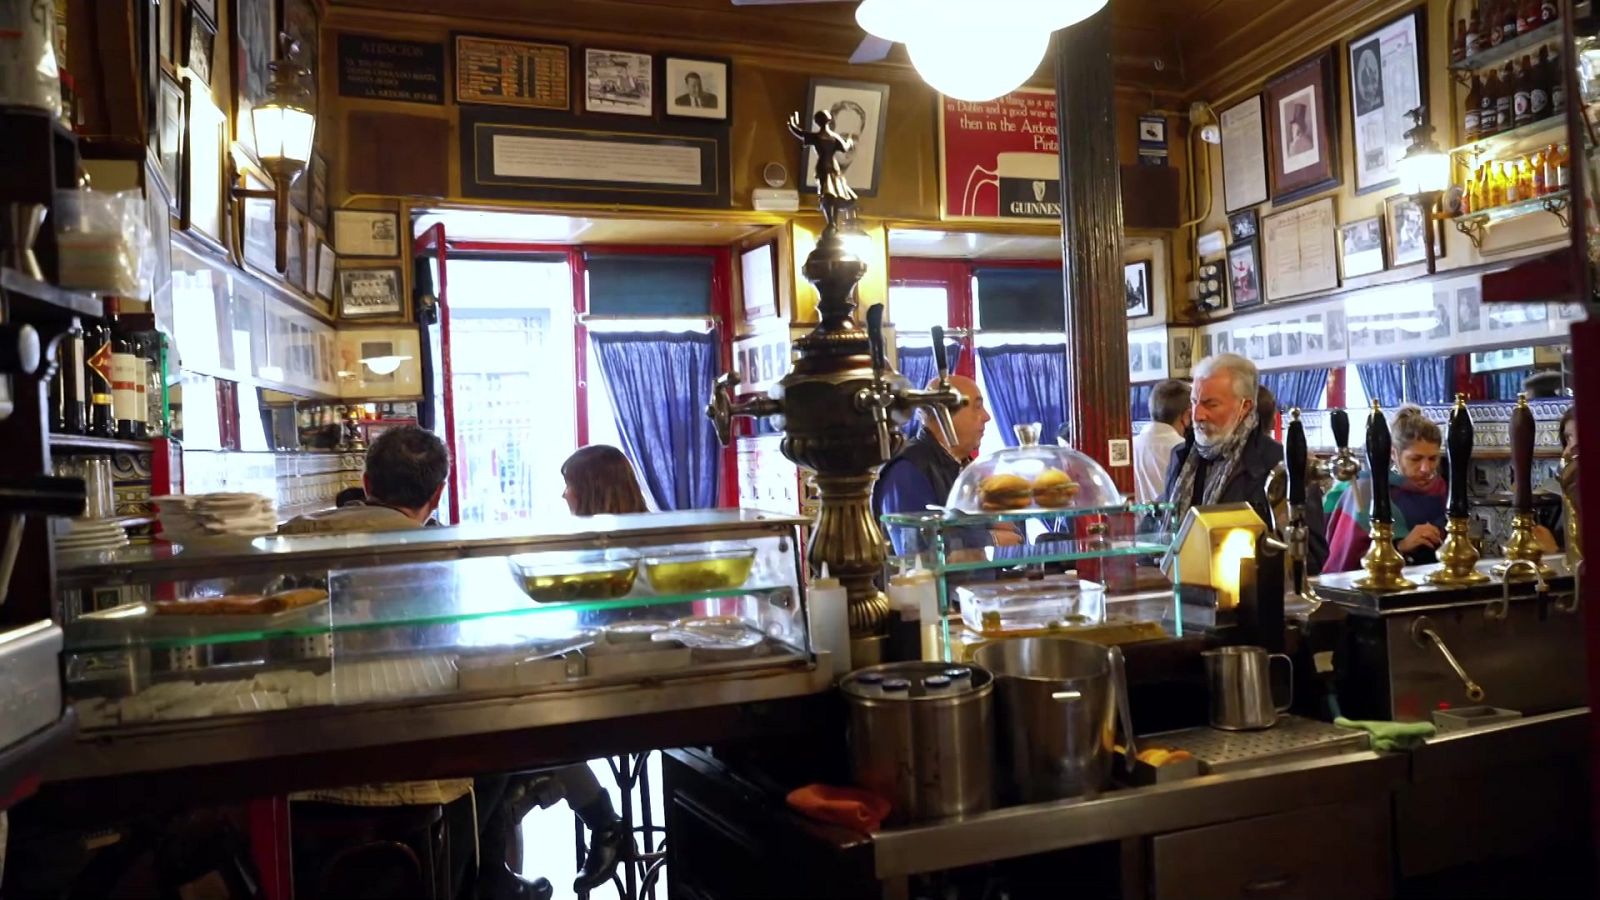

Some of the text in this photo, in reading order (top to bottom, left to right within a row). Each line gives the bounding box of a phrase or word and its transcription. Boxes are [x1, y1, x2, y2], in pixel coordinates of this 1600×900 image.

[957, 101, 984, 113] Dublin
[986, 102, 1000, 114] and
[1009, 106, 1028, 118] good
[960, 114, 1058, 134] then in the Ardosa
[1033, 134, 1058, 150] Pinta
[1010, 201, 1062, 215] GUINNES
